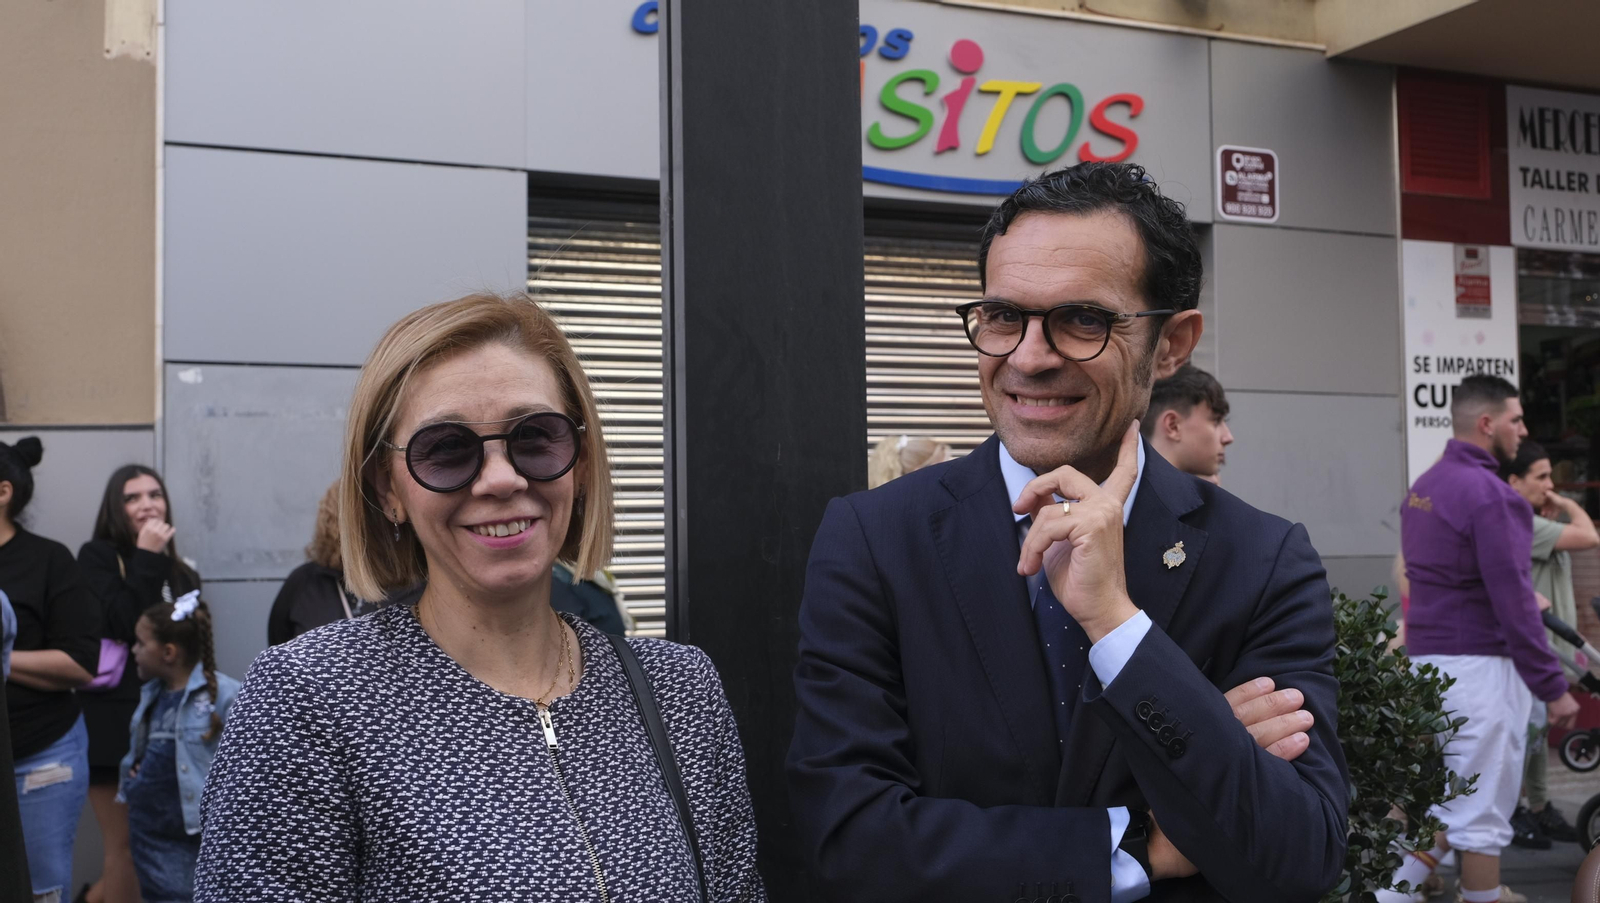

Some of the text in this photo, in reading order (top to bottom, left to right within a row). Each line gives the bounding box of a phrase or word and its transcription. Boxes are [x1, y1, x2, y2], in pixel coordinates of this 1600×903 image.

[1517, 106, 1600, 156] MERCE
[1519, 166, 1589, 193] TALLER
[1414, 356, 1514, 375] SE IMPARTEN
[1414, 384, 1461, 408] CU
[1415, 416, 1452, 428] PERSO
